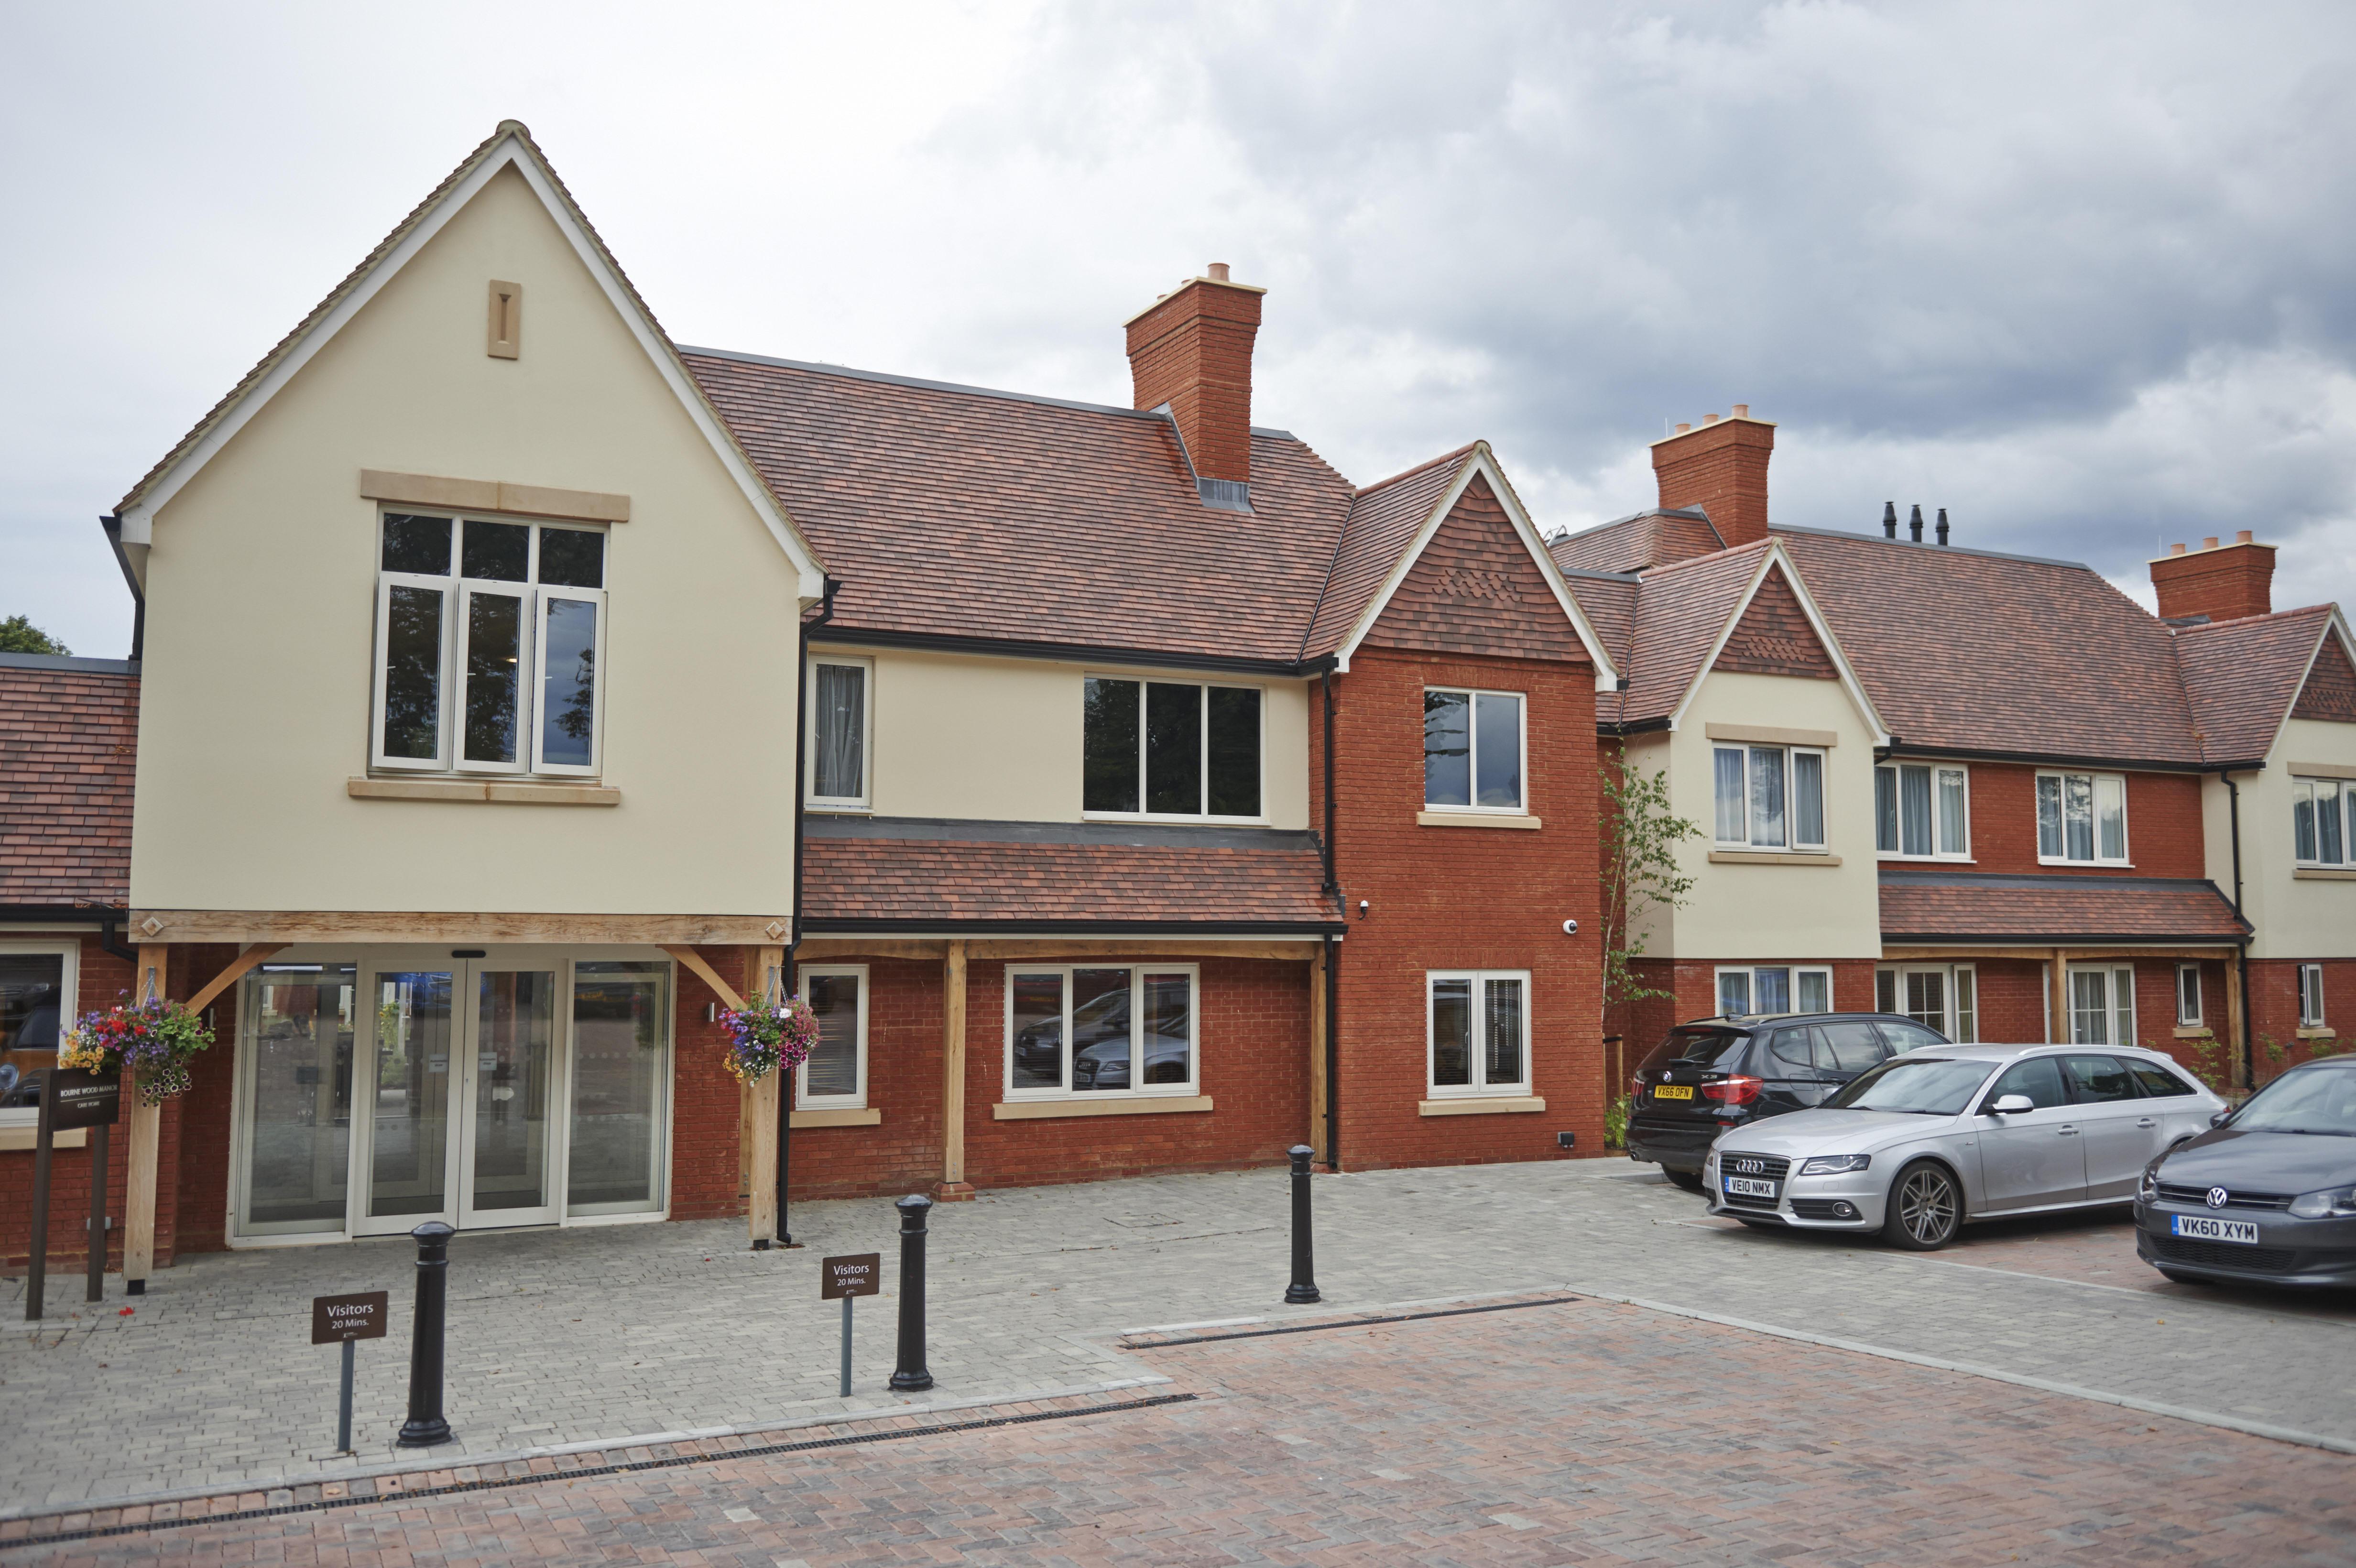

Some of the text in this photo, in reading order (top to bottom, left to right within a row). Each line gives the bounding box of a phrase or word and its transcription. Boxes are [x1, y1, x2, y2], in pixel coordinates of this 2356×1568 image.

[60, 1089, 81, 1097] BOURNE
[99, 1084, 118, 1092] MANOR
[1658, 1087, 1690, 1097] VX66 OFN
[1753, 1182, 1770, 1195] NMX
[2182, 1218, 2255, 1240] VK60 XYM
[833, 1264, 869, 1275] Visitors
[327, 1304, 374, 1317] Visitors
[332, 1318, 369, 1329] 20 Mins.
